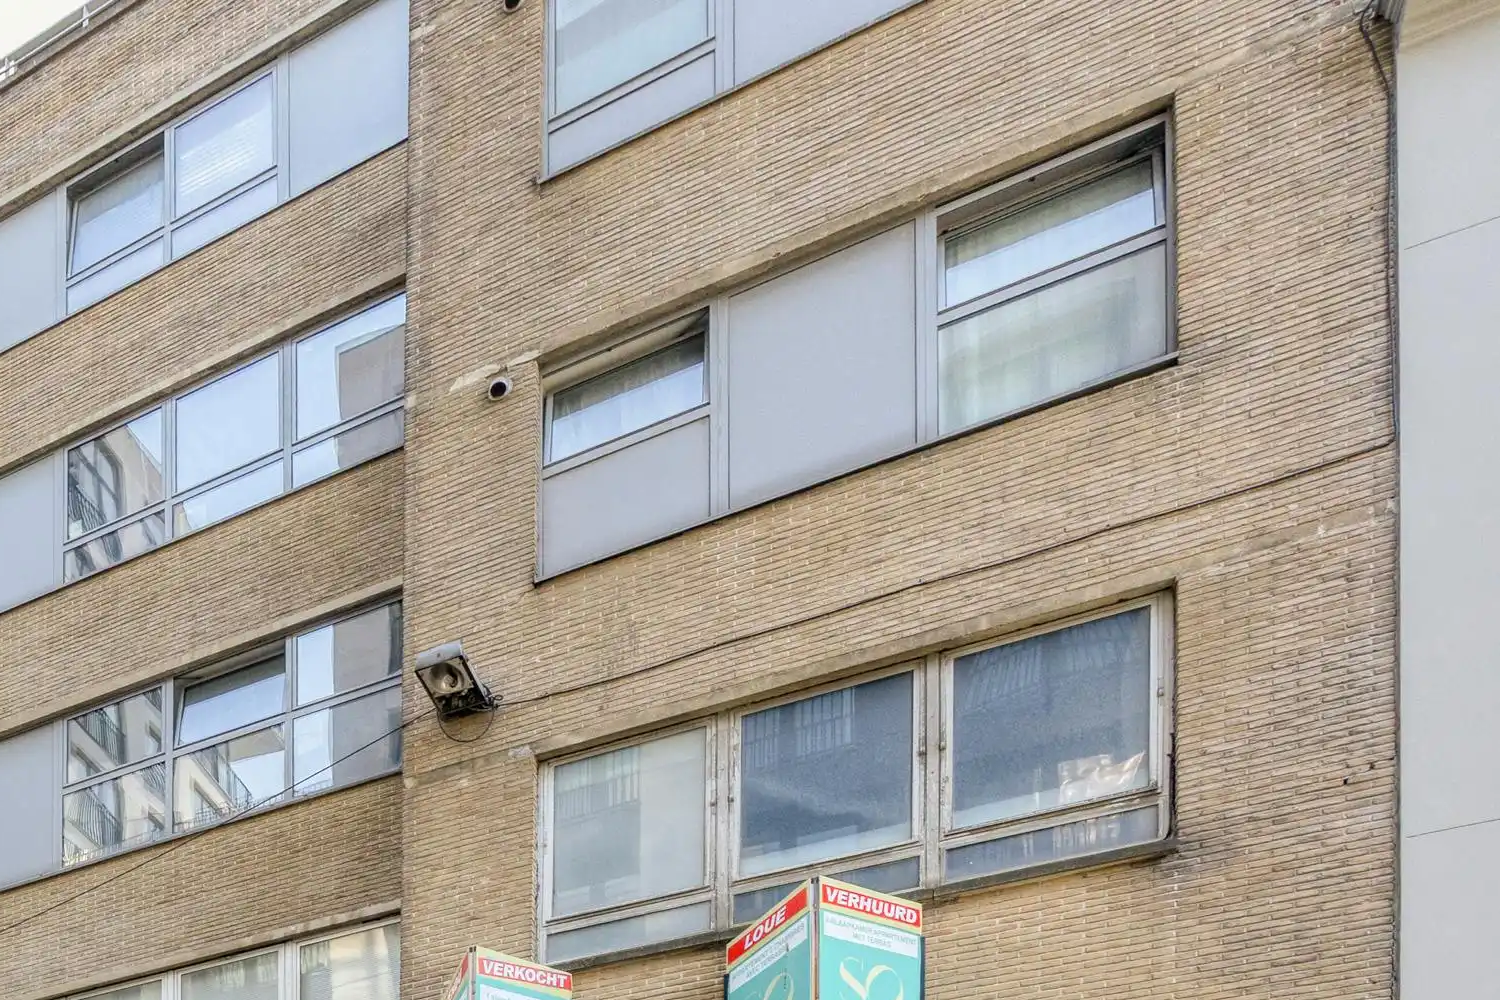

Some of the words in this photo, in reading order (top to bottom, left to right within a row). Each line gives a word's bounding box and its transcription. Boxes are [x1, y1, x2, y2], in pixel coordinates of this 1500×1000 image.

[826, 886, 918, 923] VERHUURD
[743, 904, 787, 950] LOUE
[482, 959, 568, 988] VERKOCHT
